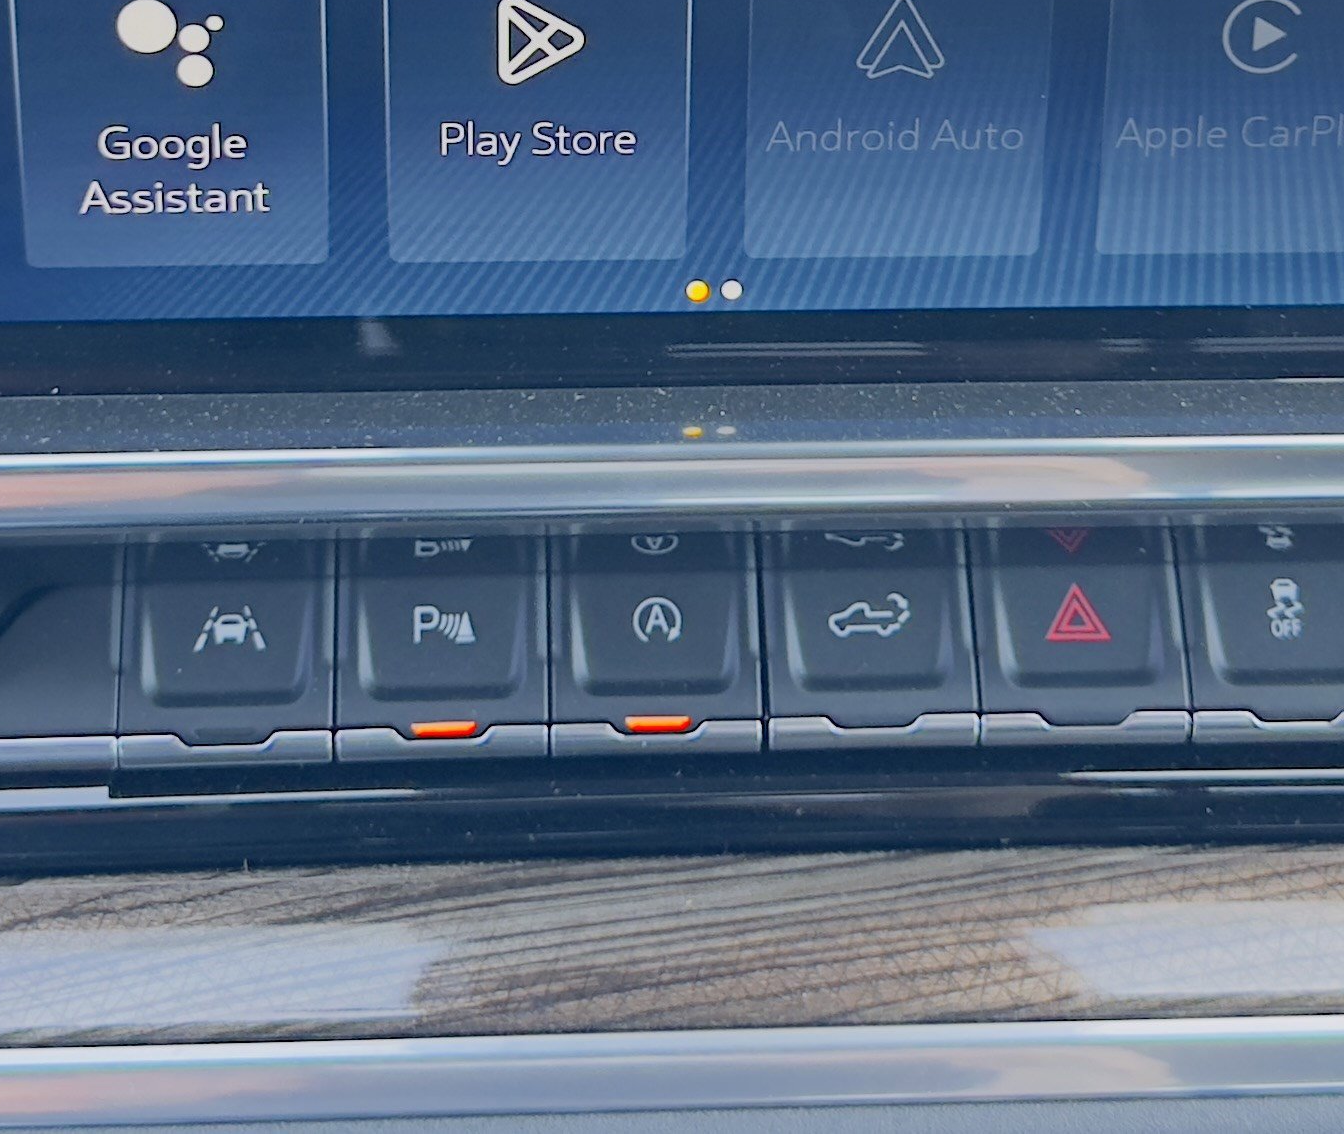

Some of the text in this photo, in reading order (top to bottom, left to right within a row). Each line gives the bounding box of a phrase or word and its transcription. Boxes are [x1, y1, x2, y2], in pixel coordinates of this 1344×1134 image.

[97, 123, 249, 169] Google
[438, 121, 638, 165] Play Store
[765, 118, 1025, 154] Android Auto
[1115, 114, 1227, 158] Apple
[79, 180, 271, 216] Assistant
[1269, 617, 1305, 641] OFF
